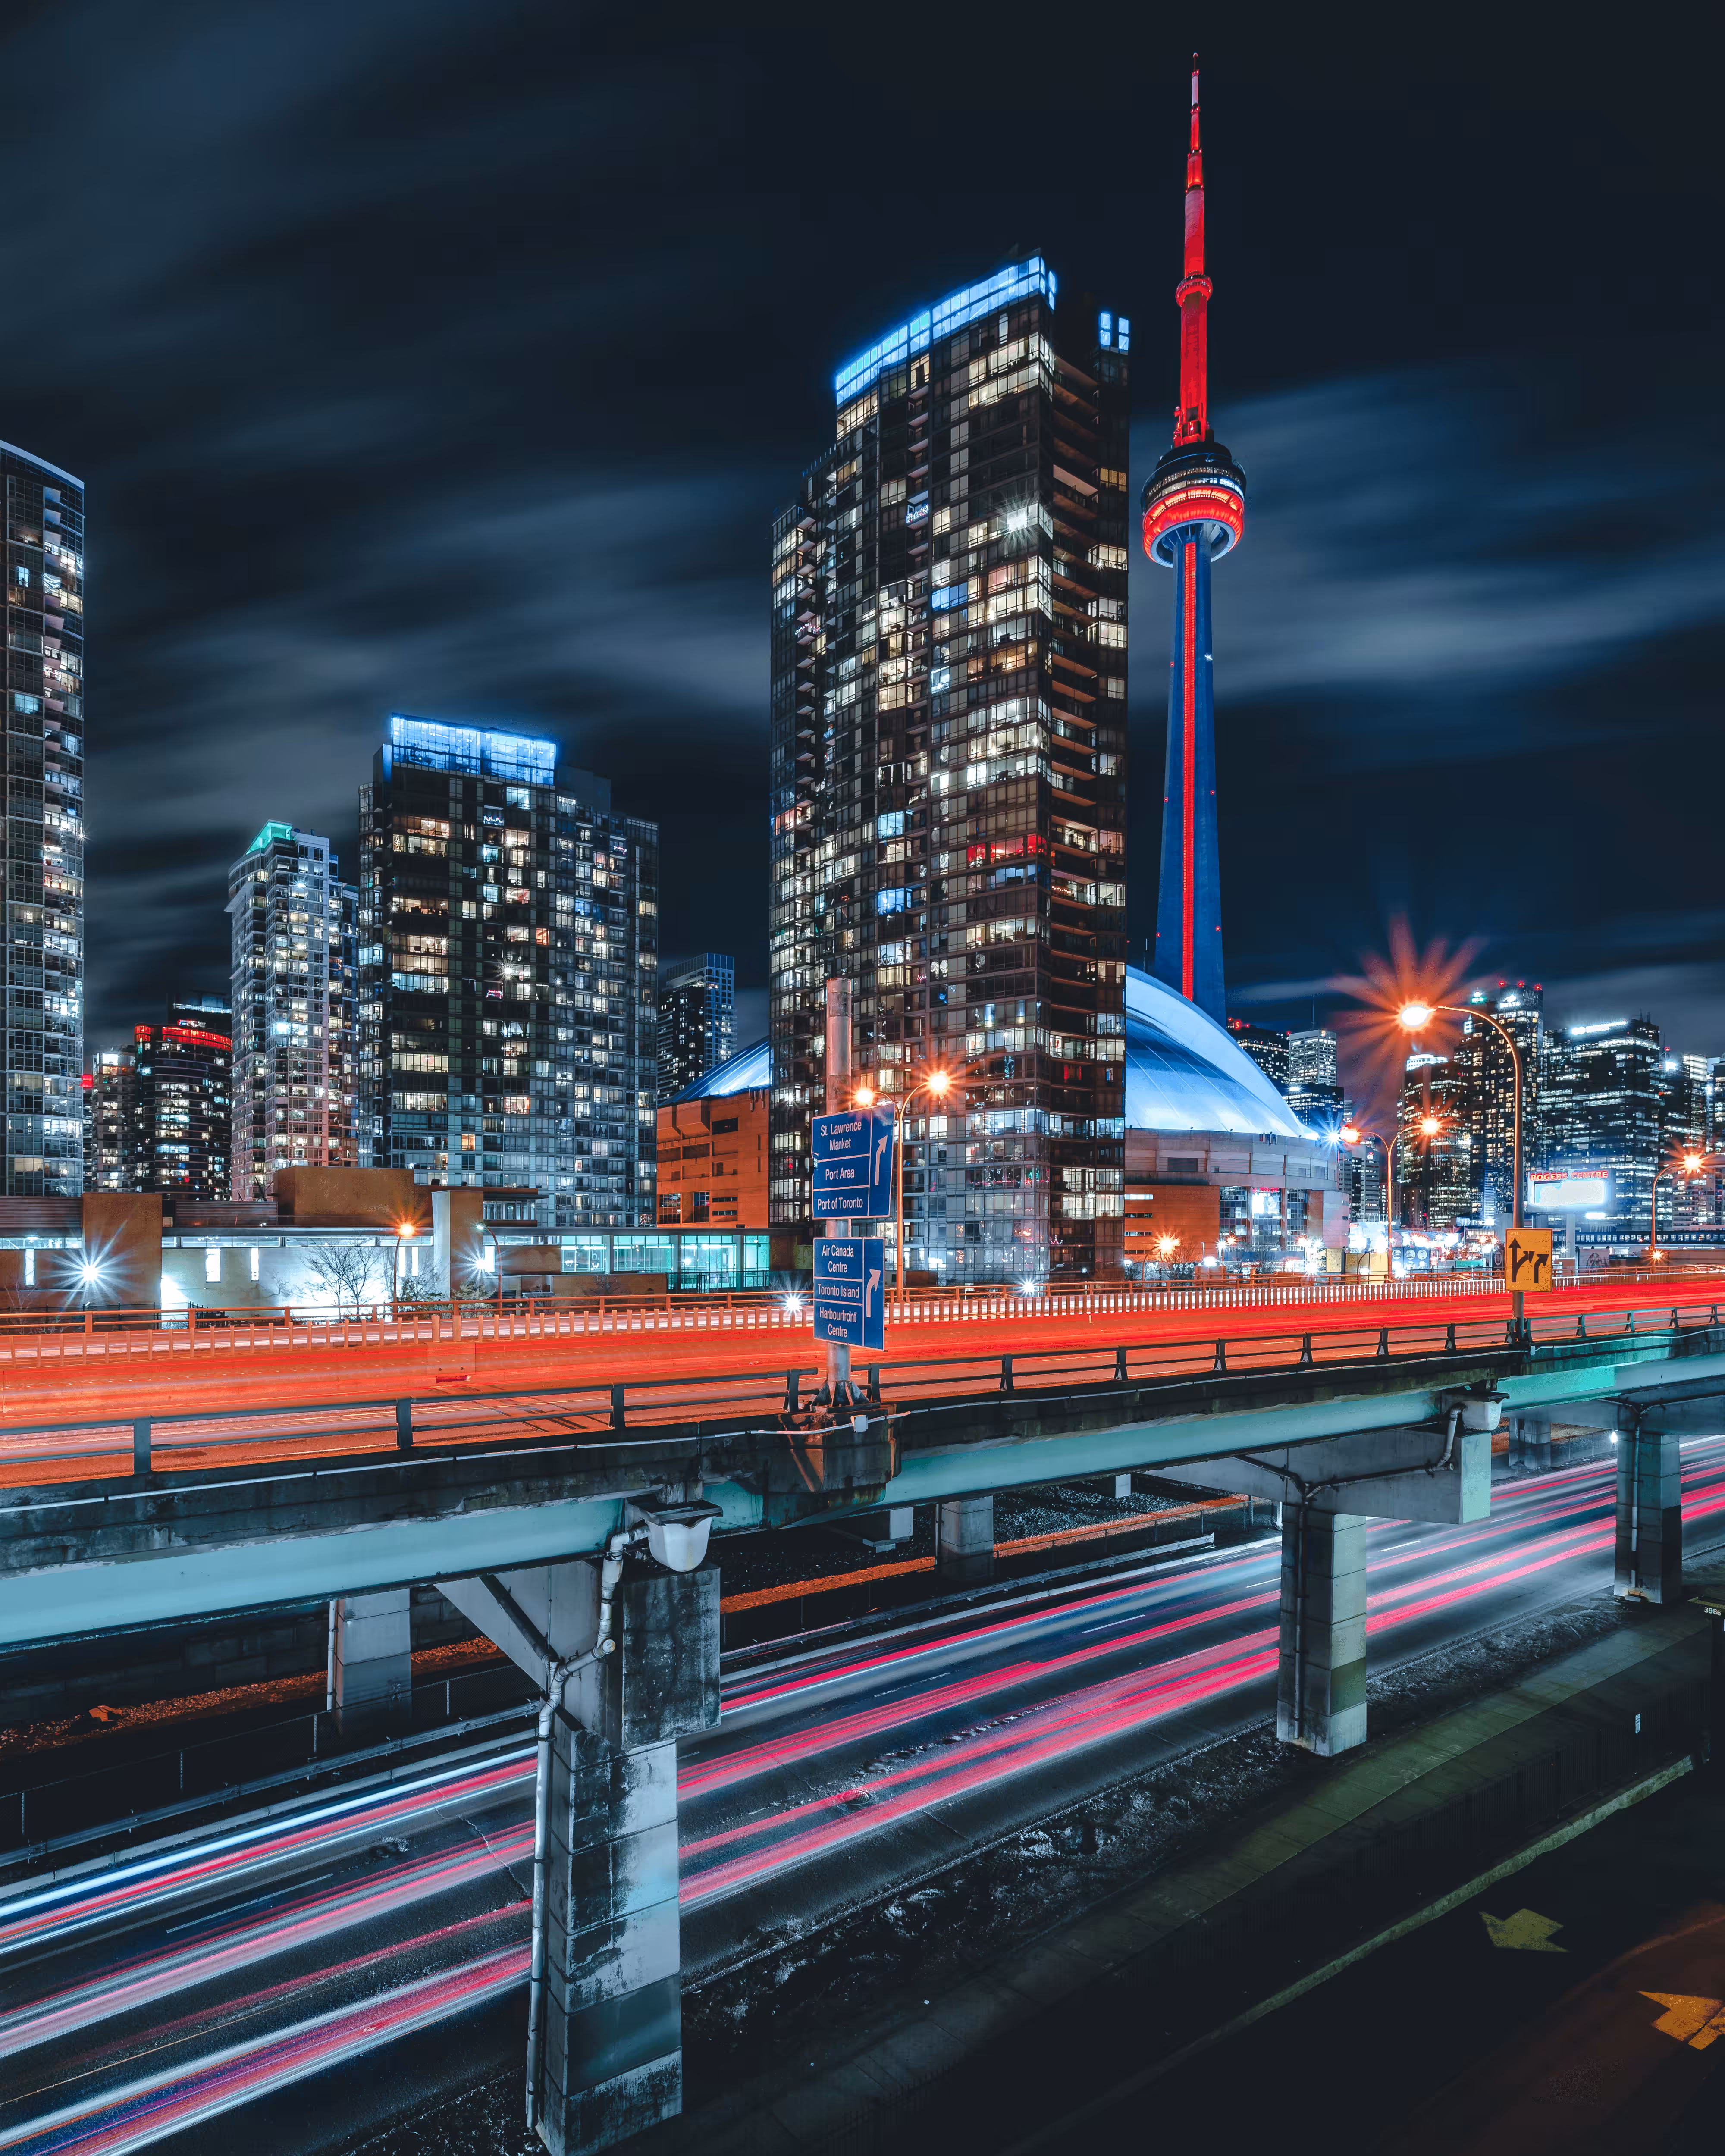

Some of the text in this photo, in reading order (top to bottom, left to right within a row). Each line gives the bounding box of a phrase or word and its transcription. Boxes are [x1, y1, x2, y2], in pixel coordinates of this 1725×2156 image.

[821, 1121, 862, 1137] St. Lawrence
[830, 1137, 851, 1151] Market
[825, 1167, 854, 1180] Port Area
[1530, 1170, 1608, 1181] ROGERS CENTRE
[818, 1197, 863, 1210] Port of Toronto
[822, 1244, 854, 1257] Air Canada
[828, 1260, 847, 1273] Centre
[818, 1283, 859, 1298] Toronto Island
[819, 1307, 857, 1323] Harbourfront
[828, 1323, 847, 1338] Centre
[1704, 1607, 1721, 1616] 3986
